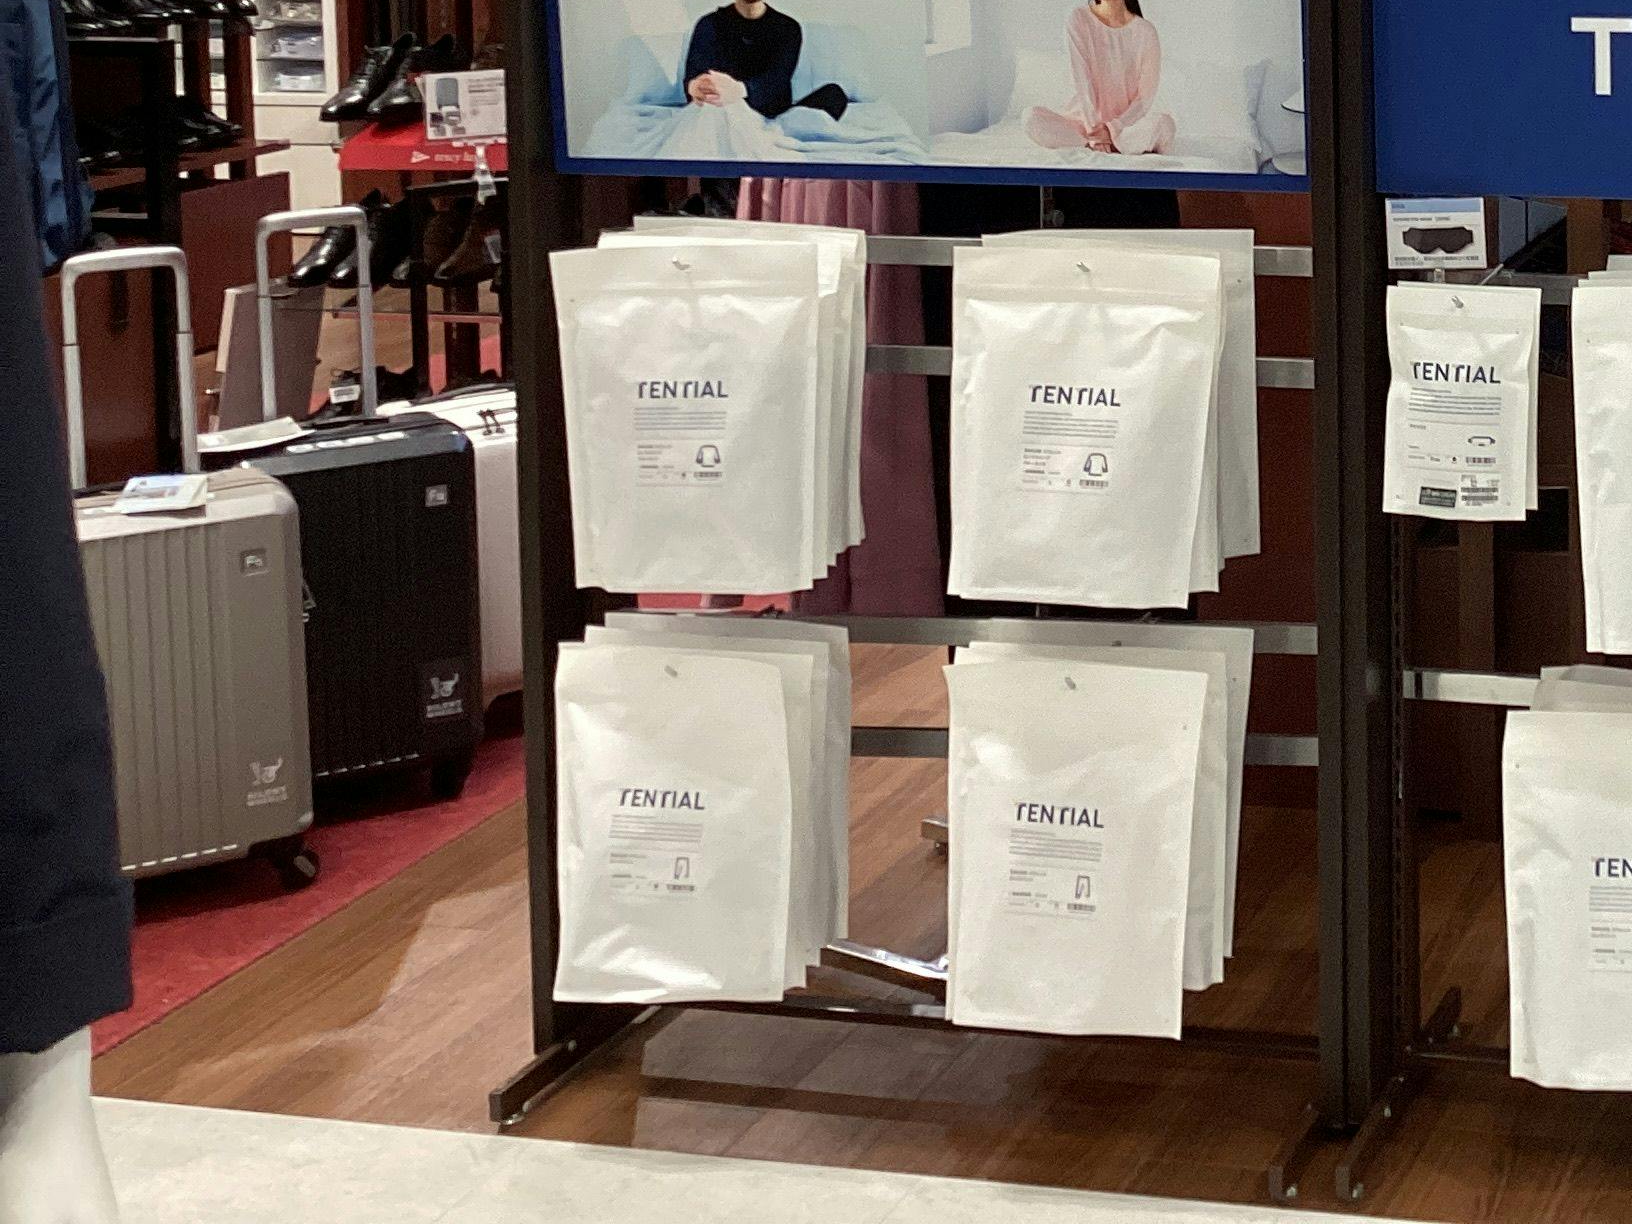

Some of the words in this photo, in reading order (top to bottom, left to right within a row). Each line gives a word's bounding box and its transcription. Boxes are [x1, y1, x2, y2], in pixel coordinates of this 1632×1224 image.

[1411, 360, 1501, 384] TENTIAL
[638, 380, 729, 399] TENTIAL
[1028, 385, 1121, 407] TENTIAL
[620, 788, 705, 810] TENTIAL
[1015, 802, 1105, 828] TENTIAL
